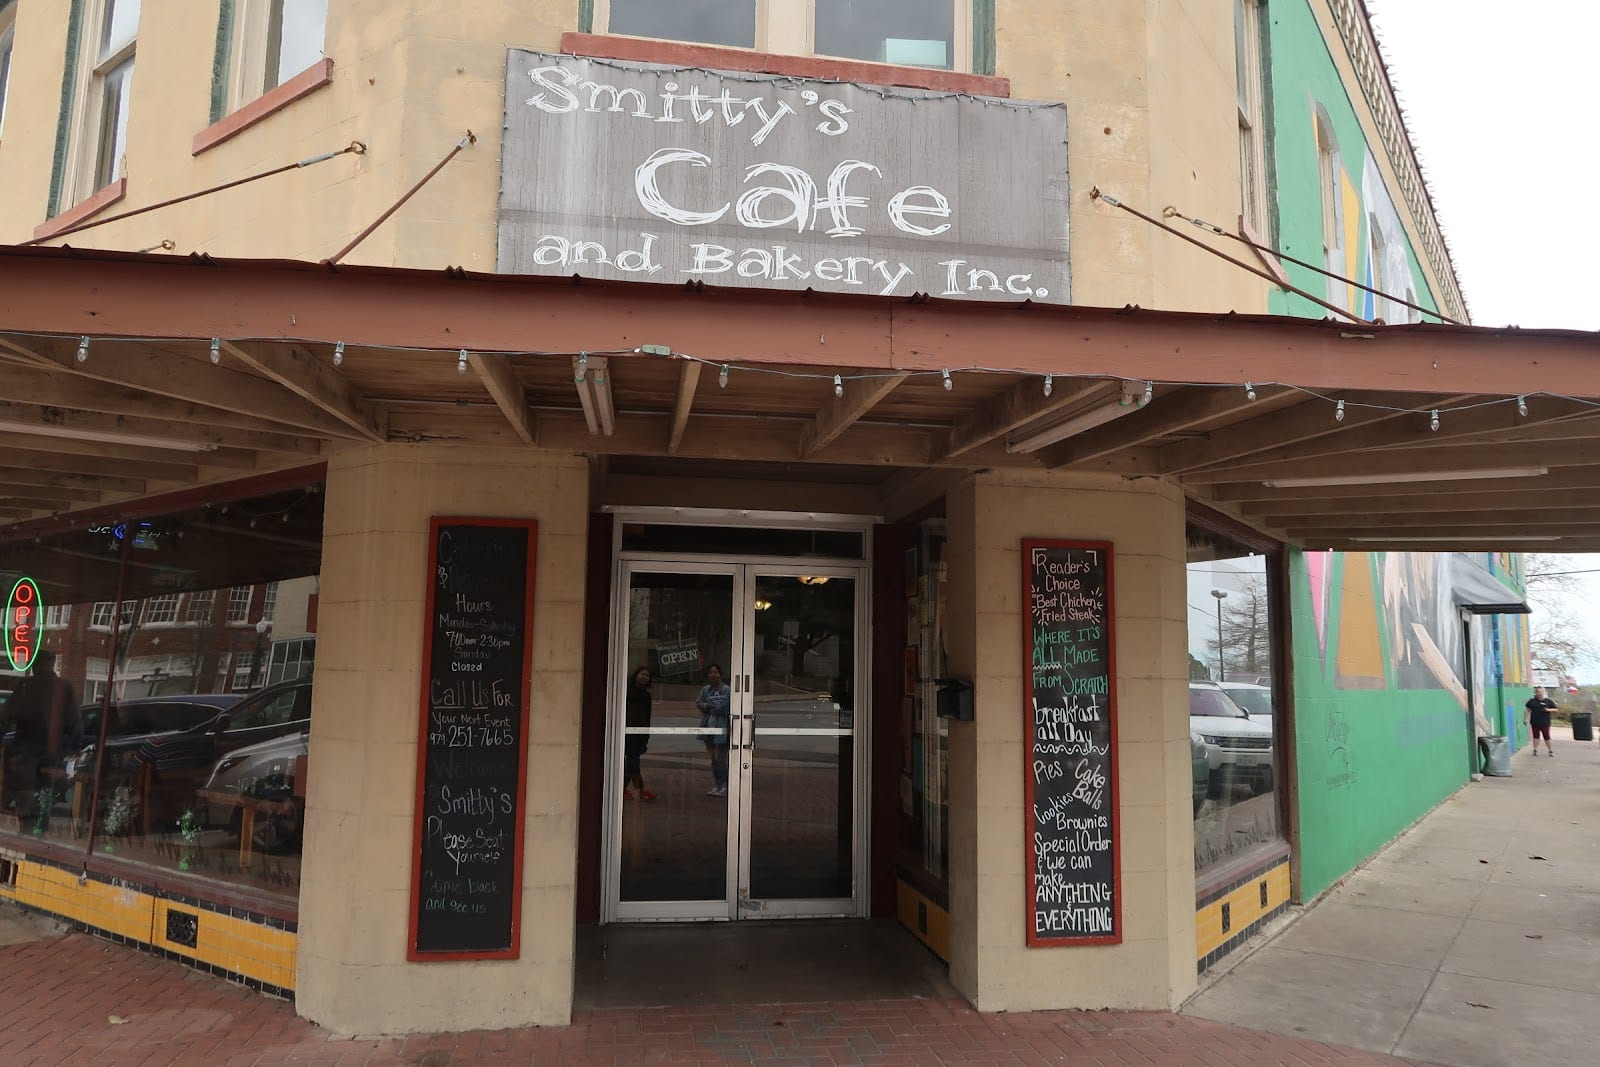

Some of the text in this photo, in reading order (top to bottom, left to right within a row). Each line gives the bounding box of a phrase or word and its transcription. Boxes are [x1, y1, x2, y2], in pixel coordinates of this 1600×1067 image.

[525, 65, 854, 147] Smitty's
[634, 147, 953, 237] Cafe
[532, 232, 1049, 299] and Bakery Inc.
[1036, 553, 1090, 575] Reader's
[1045, 575, 1081, 592] Choice
[455, 593, 492, 613] Hours
[1037, 592, 1098, 609] Best Chicken
[14, 584, 34, 663] OPEN
[1042, 608, 1095, 623] Fried Steak
[451, 661, 483, 672] Closed
[661, 648, 698, 666] OPEN
[431, 679, 466, 706] Call
[484, 713, 511, 728] Event
[1033, 694, 1100, 724] breakfast
[1038, 722, 1092, 750] all Day
[1033, 760, 1064, 784] Pies
[1074, 758, 1106, 789] Cake
[438, 785, 513, 824] Smitty's
[1034, 791, 1074, 824] Cookies
[1072, 780, 1103, 811] Balls
[1056, 812, 1109, 831] Brownies
[1034, 830, 1112, 860] Special Order
[1047, 856, 1067, 870] we
[1071, 856, 1092, 870] can
[1035, 868, 1066, 888] make
[1036, 882, 1112, 904] ANYTHING
[1035, 906, 1112, 933] EVERYTHING
